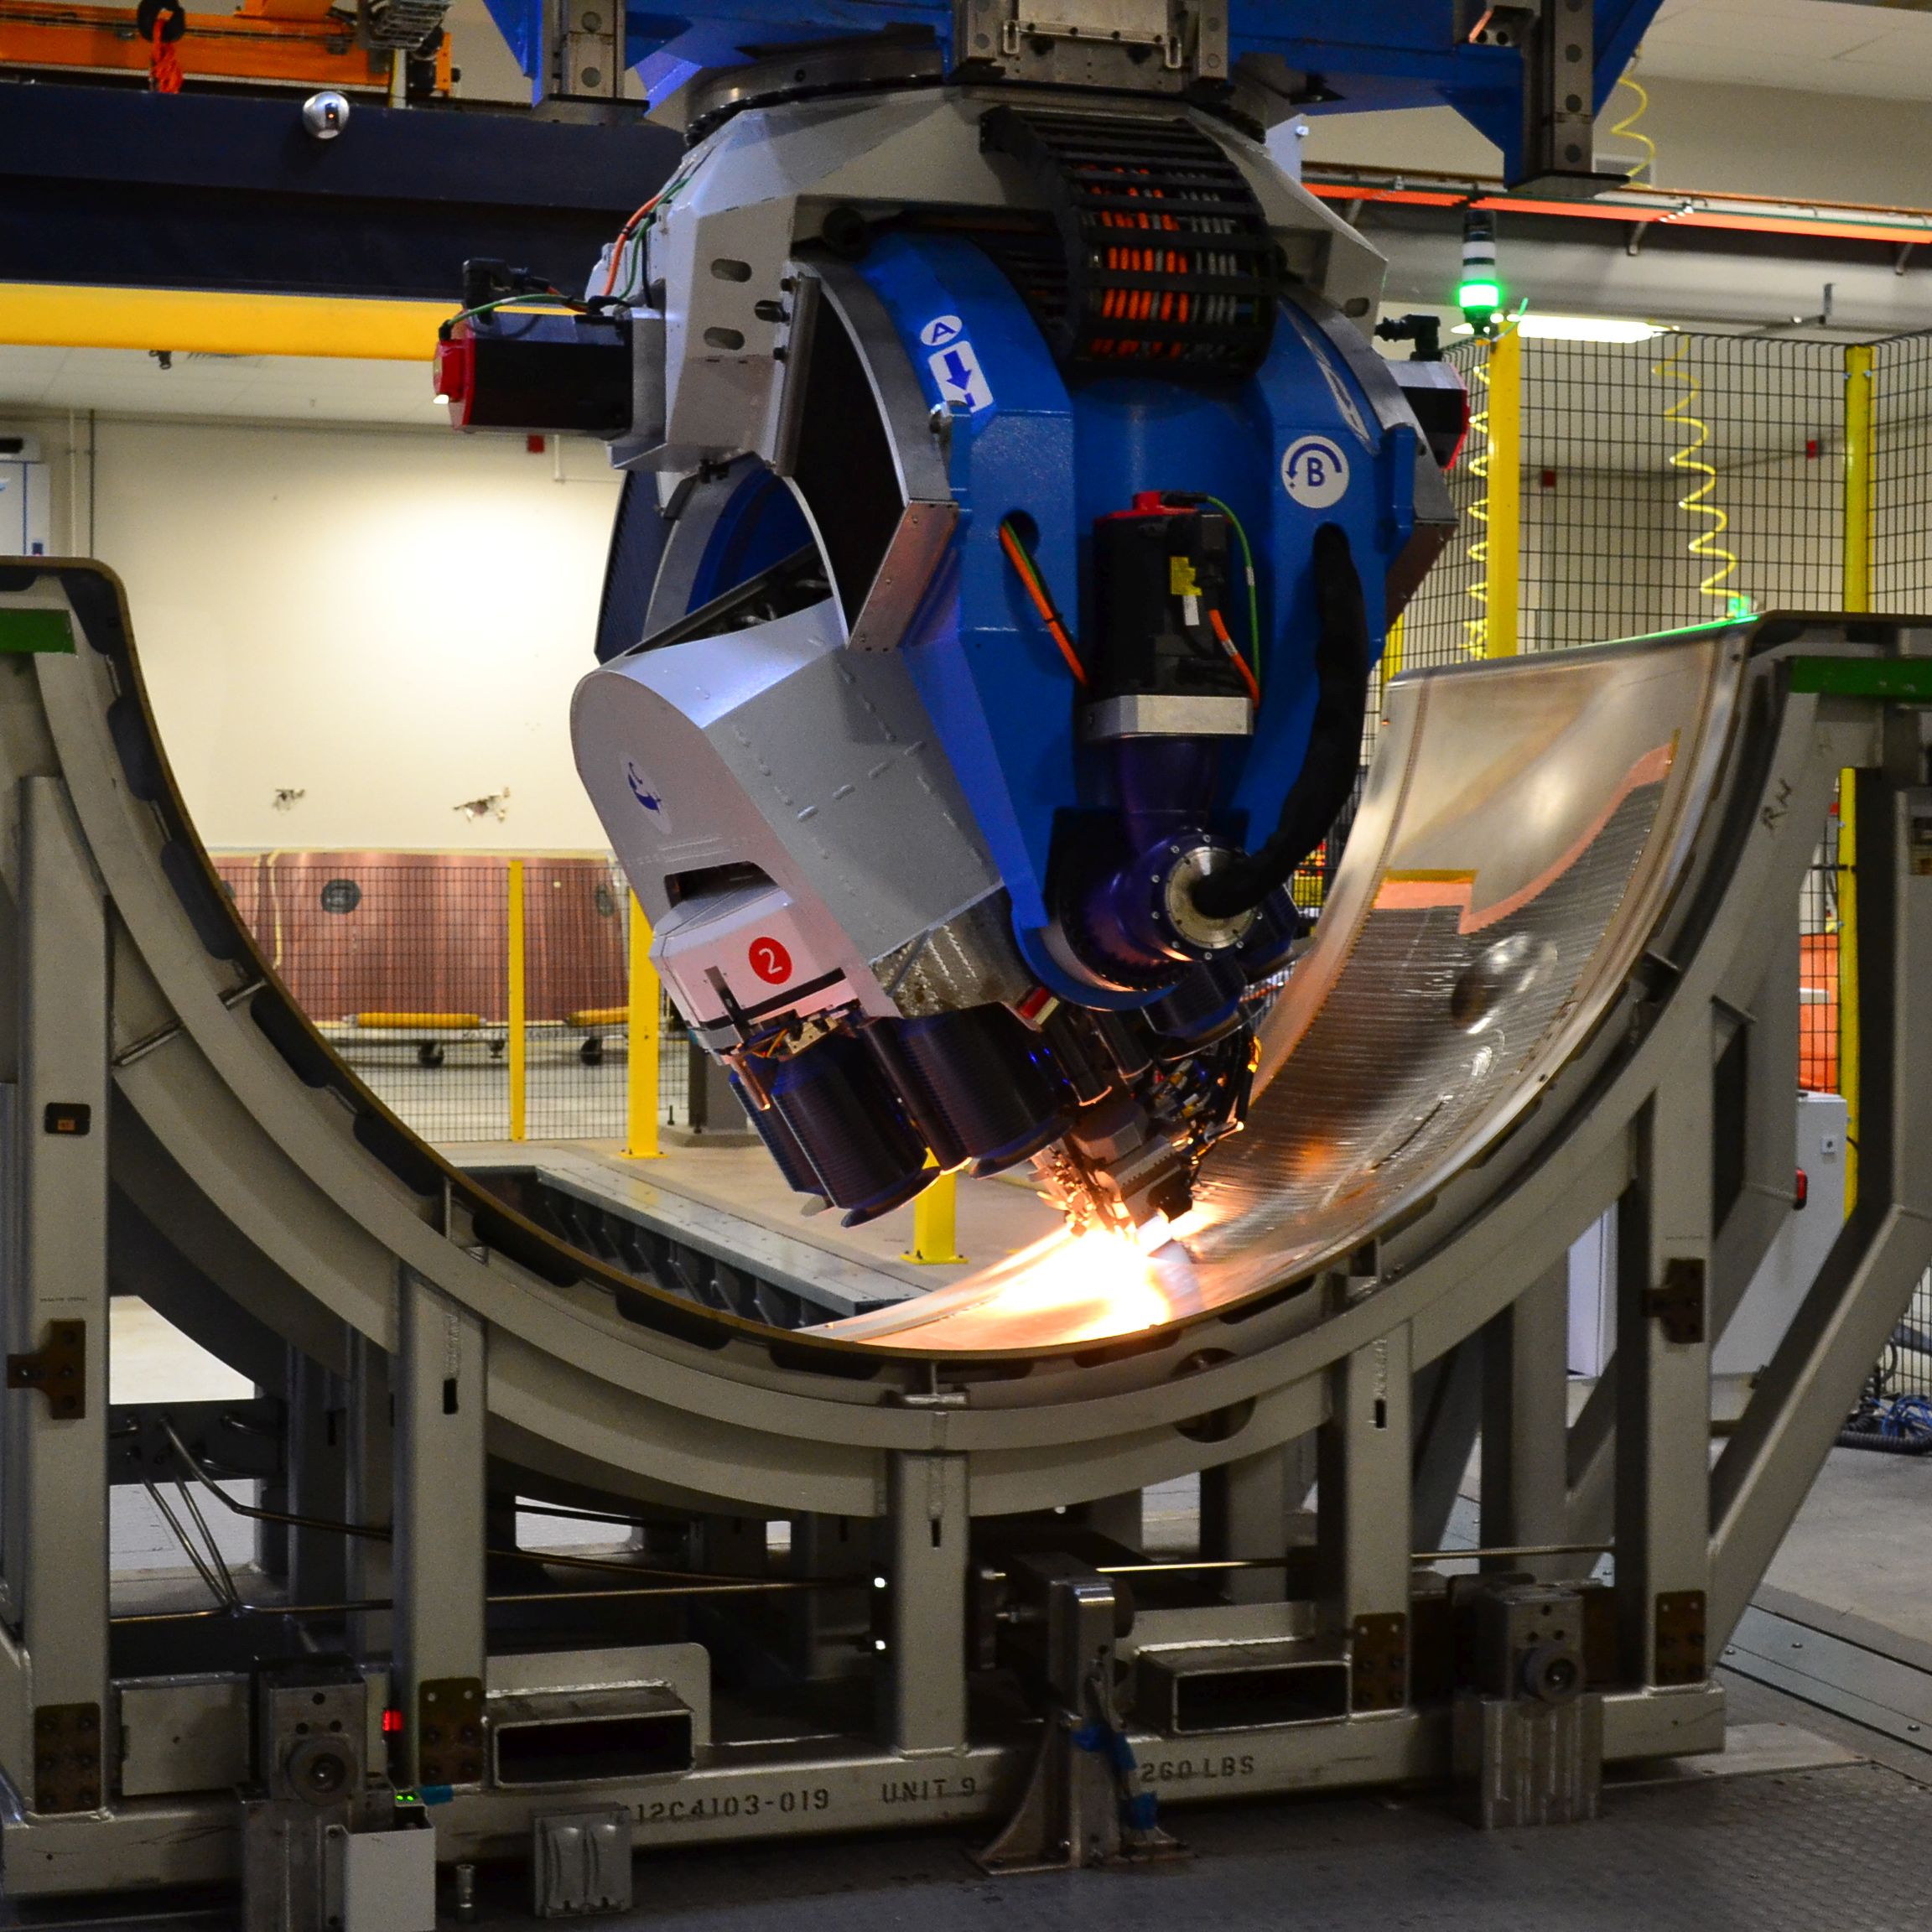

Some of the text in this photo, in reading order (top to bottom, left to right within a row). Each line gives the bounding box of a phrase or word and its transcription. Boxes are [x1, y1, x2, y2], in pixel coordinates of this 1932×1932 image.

[931, 321, 957, 344] A
[1306, 456, 1325, 487] B
[758, 947, 783, 974] 2
[624, 1787, 829, 1824] 12C4103-019
[881, 1778, 947, 1803] UNIT
[960, 1776, 976, 1796] 9
[1203, 1754, 1255, 1779] LBS
